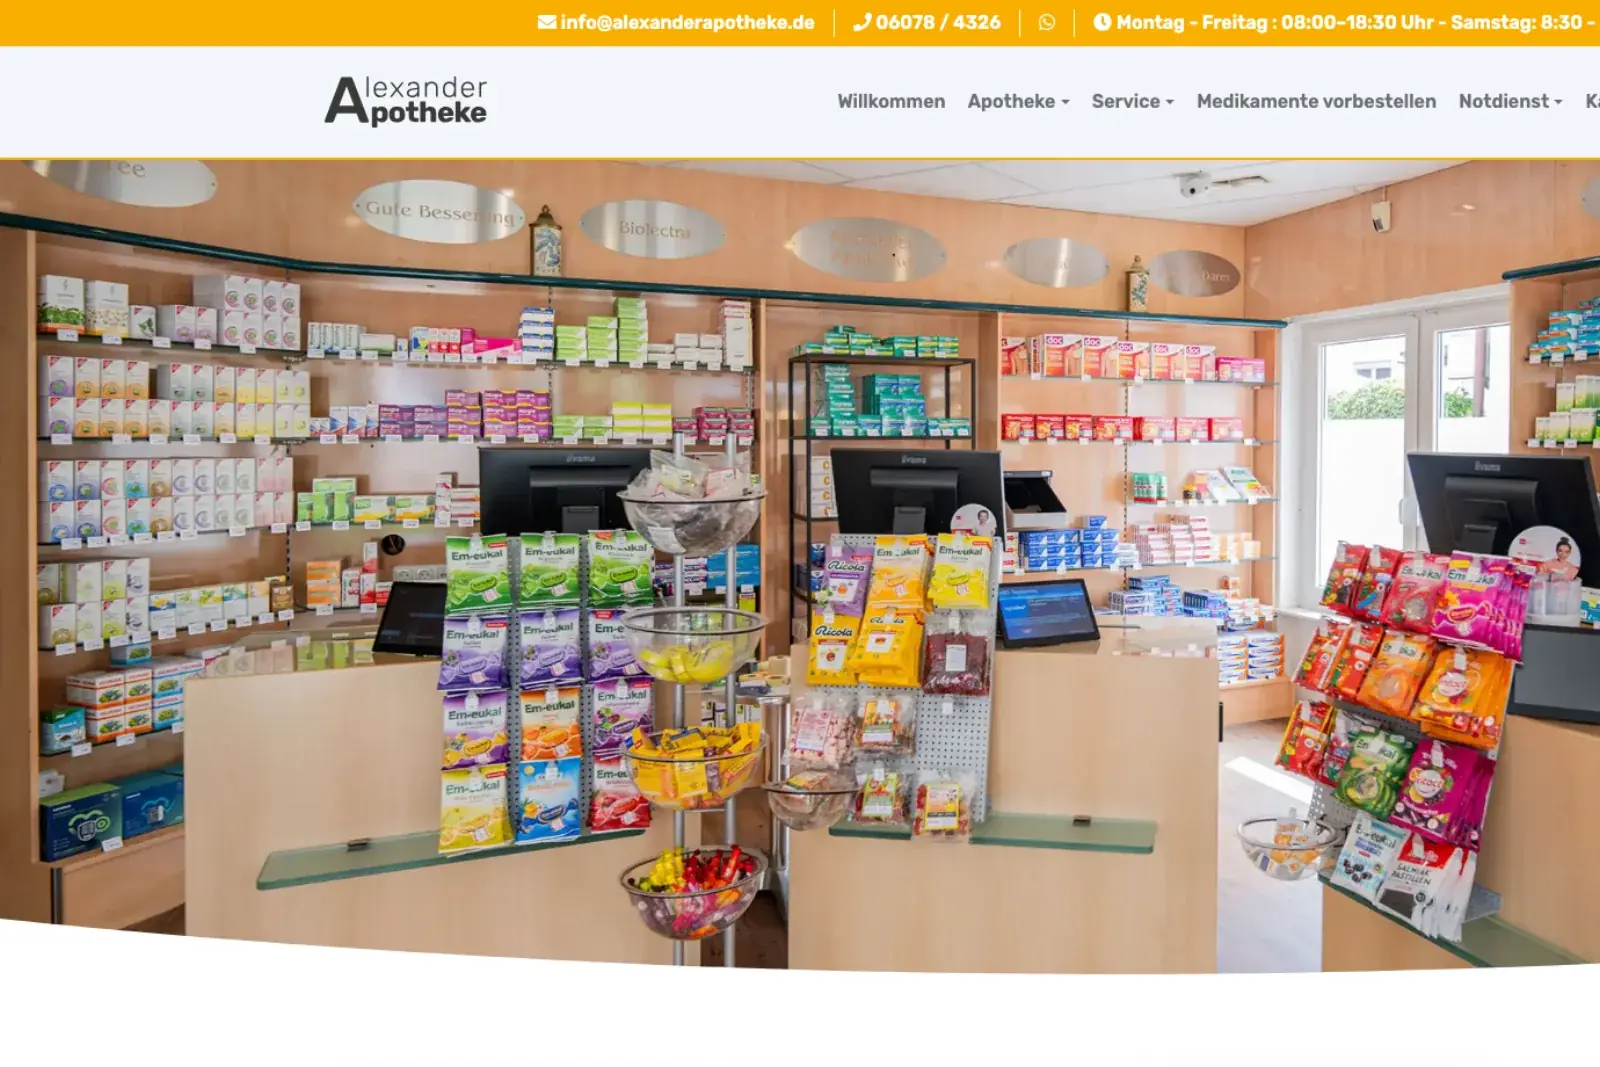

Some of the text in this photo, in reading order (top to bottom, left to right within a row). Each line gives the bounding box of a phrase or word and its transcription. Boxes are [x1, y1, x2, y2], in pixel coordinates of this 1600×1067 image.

[366, 201, 412, 217] Gute
[451, 550, 503, 561] Em-eukal
[828, 560, 866, 571] Ricola
[814, 624, 854, 637] Ricola
[525, 700, 576, 714] Em-eukal
[448, 707, 502, 721] Em-eukal
